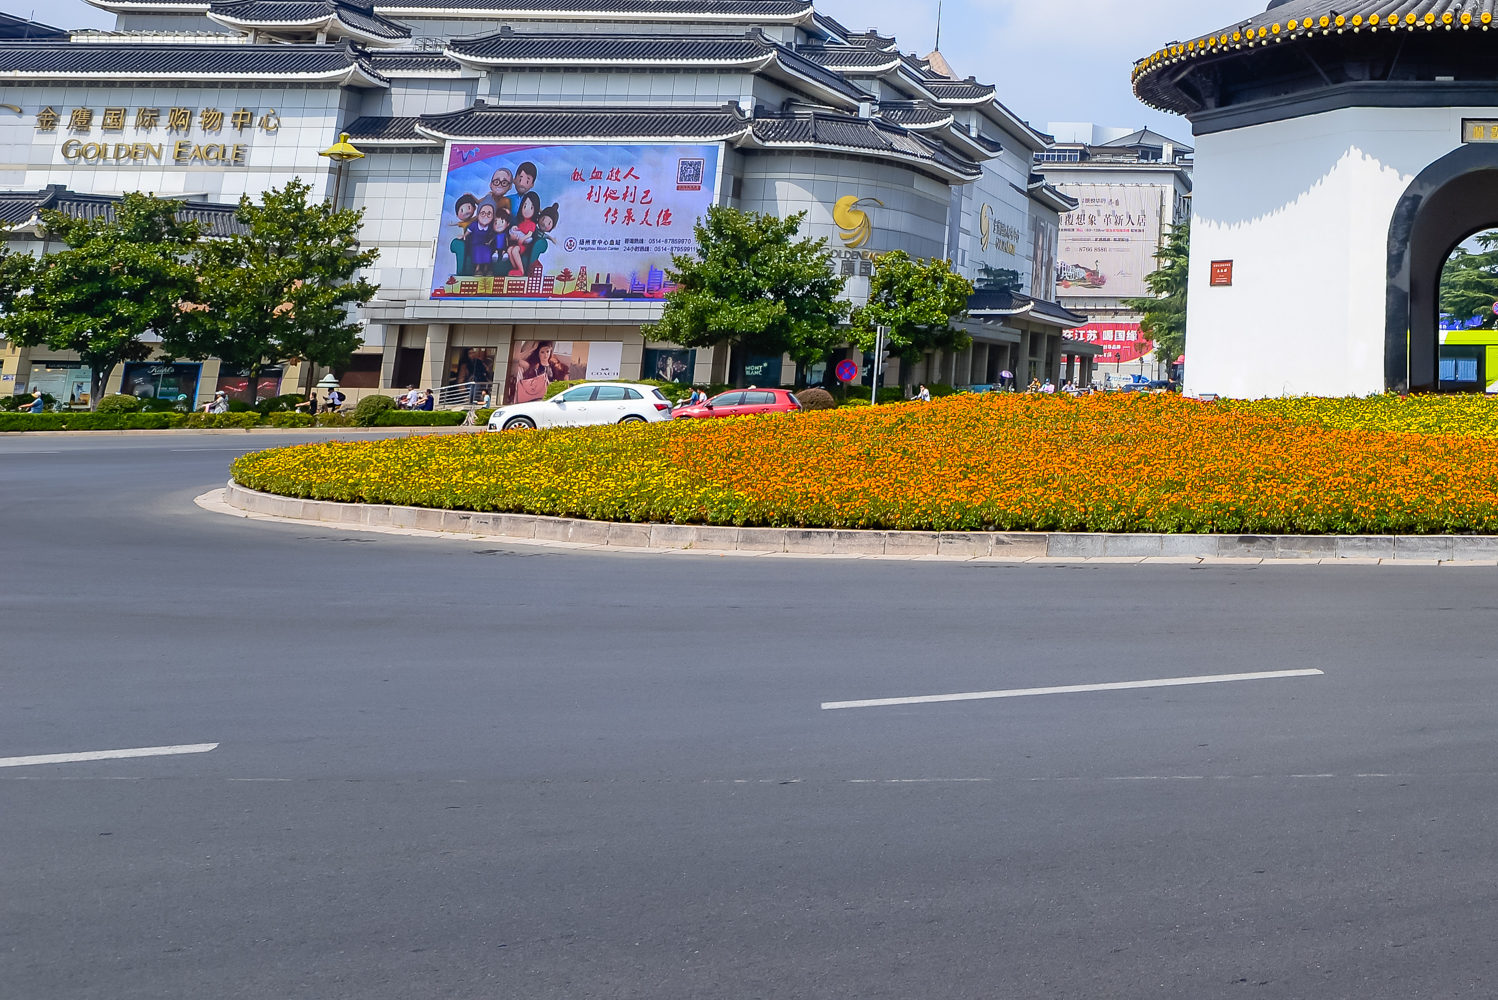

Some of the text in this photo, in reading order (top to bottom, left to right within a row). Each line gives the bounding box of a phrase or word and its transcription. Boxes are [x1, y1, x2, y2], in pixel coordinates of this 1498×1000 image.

[34, 106, 281, 132] 金鹰国际购物中心
[61, 139, 247, 162] GOLDEN EAGLE
[571, 166, 640, 182] 献血救人
[148, 365, 175, 376] Kiehl's
